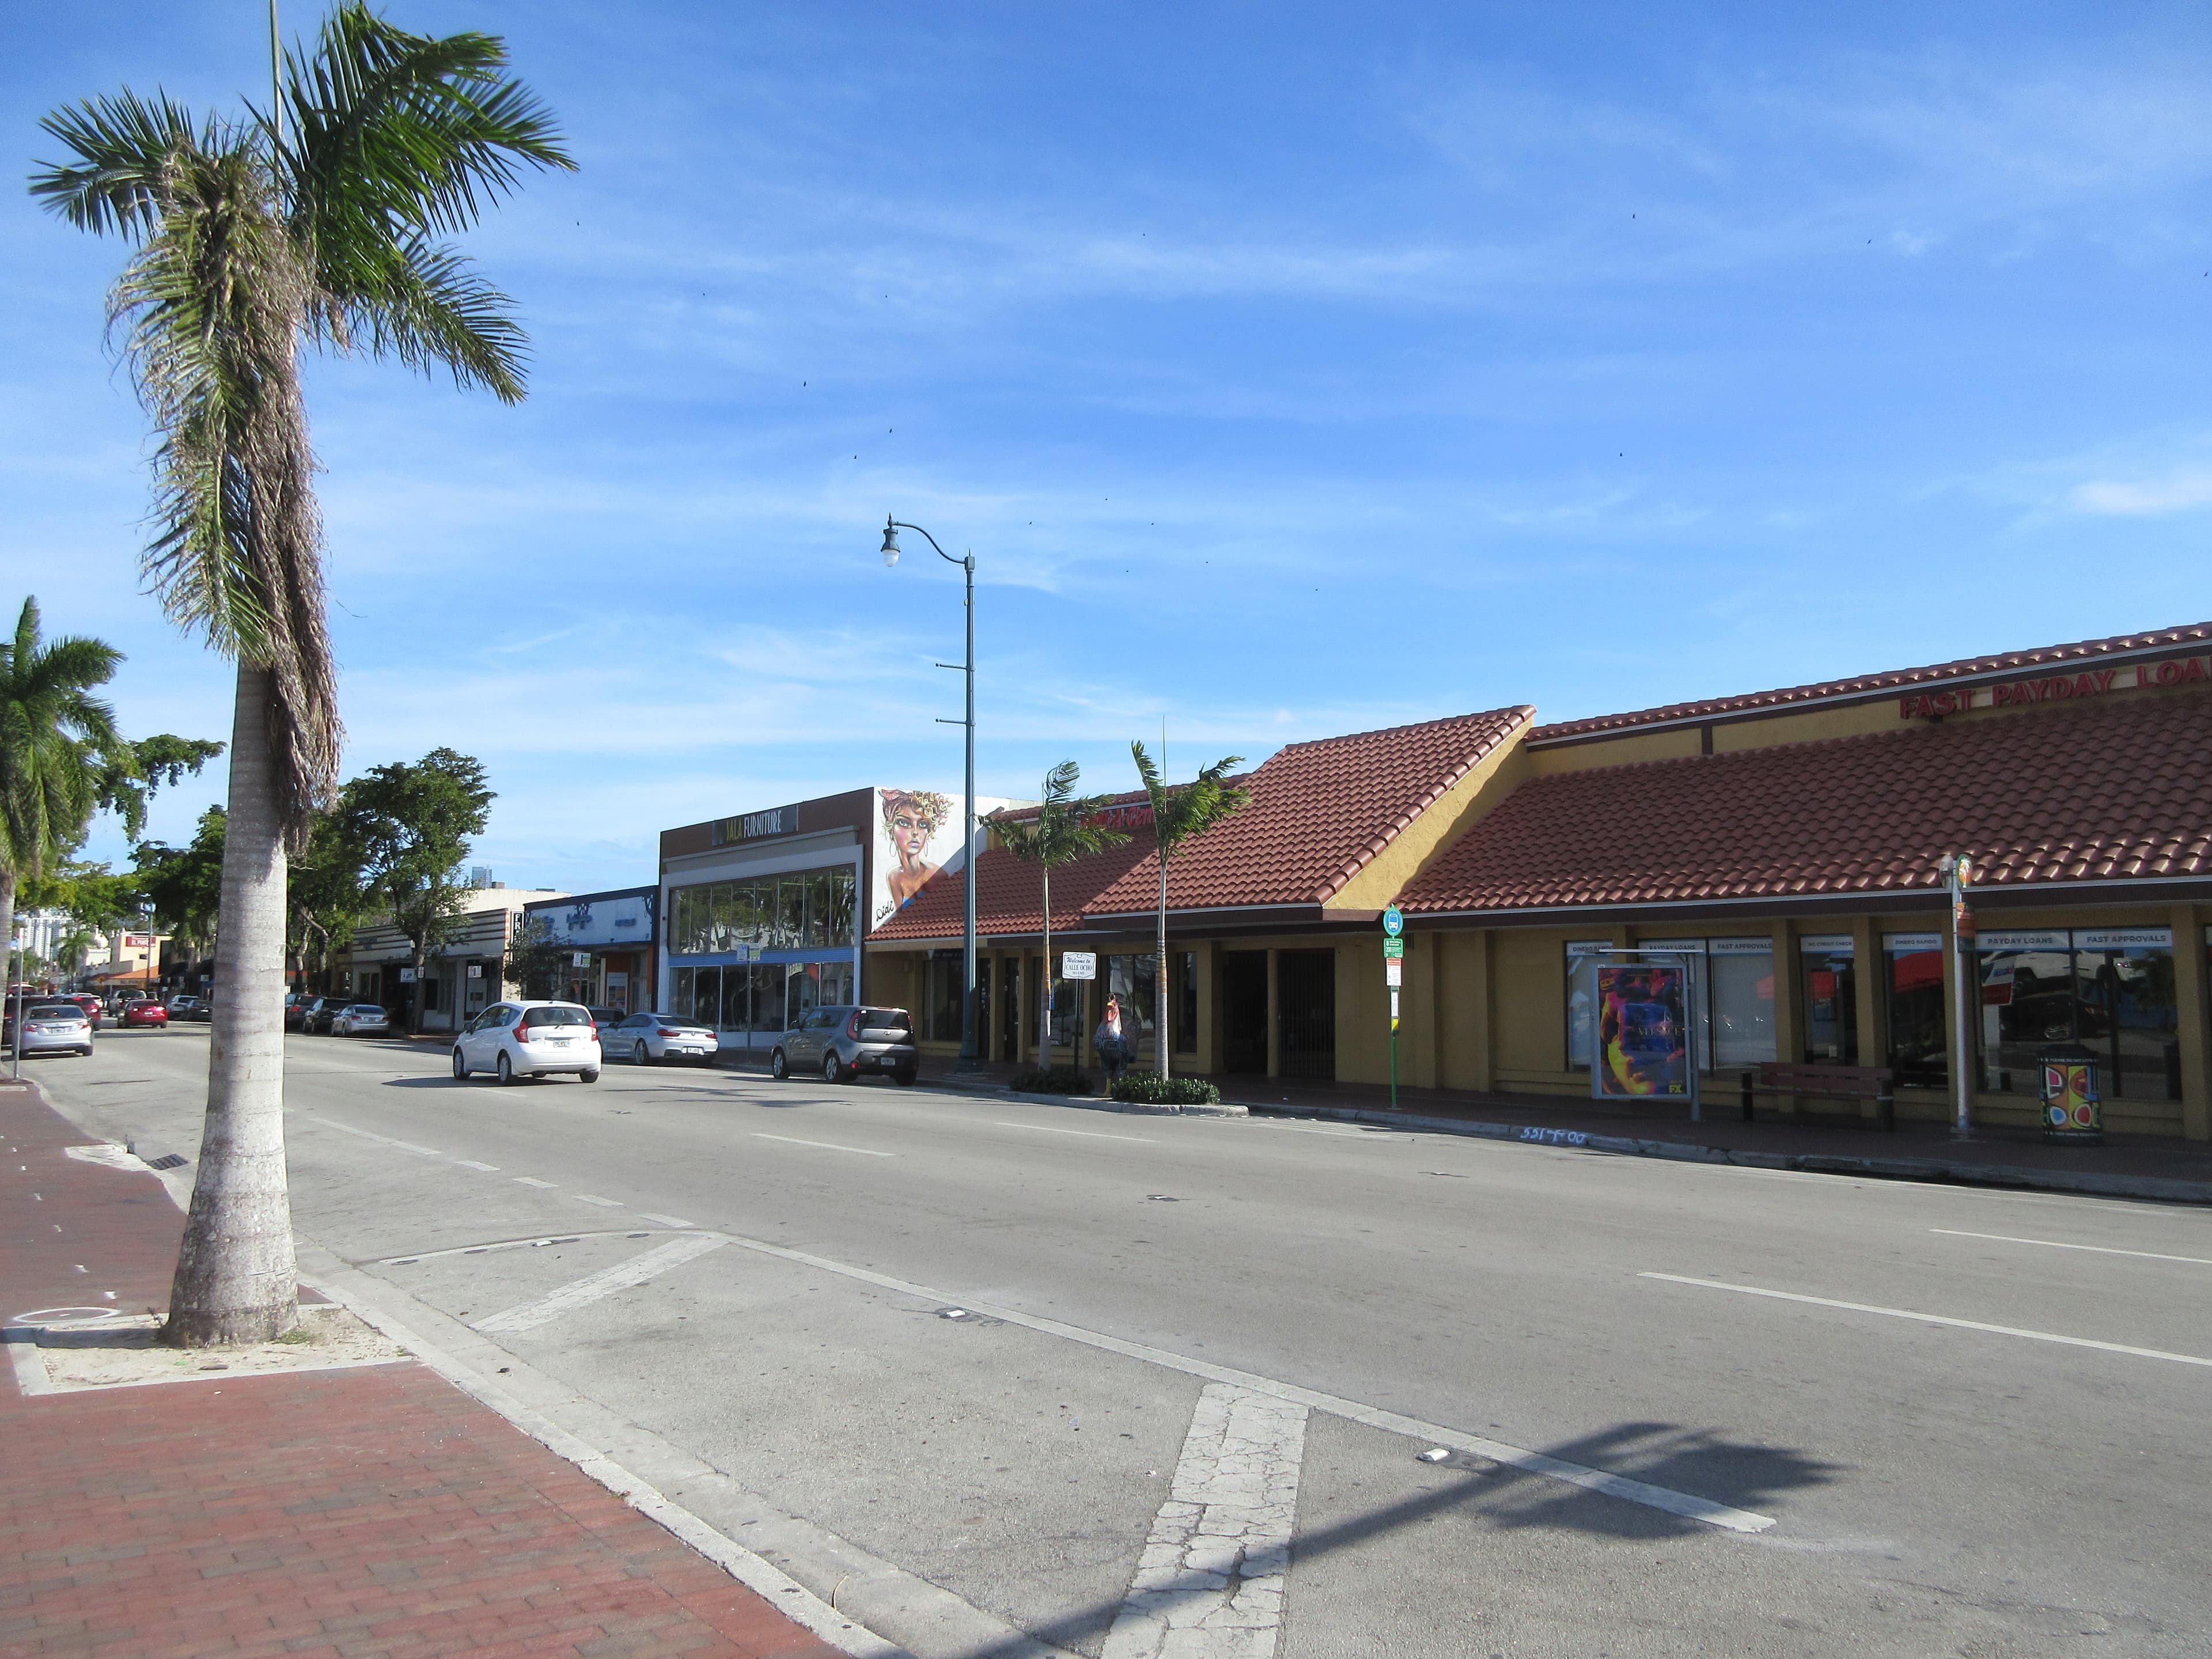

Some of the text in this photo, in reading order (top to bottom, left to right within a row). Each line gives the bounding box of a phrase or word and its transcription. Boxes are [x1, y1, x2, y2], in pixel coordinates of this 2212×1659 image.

[1899, 656, 2212, 719] FAST PAYDAY LOA
[744, 810, 782, 839] FURNITURE
[1668, 1084, 1683, 1093] FX
